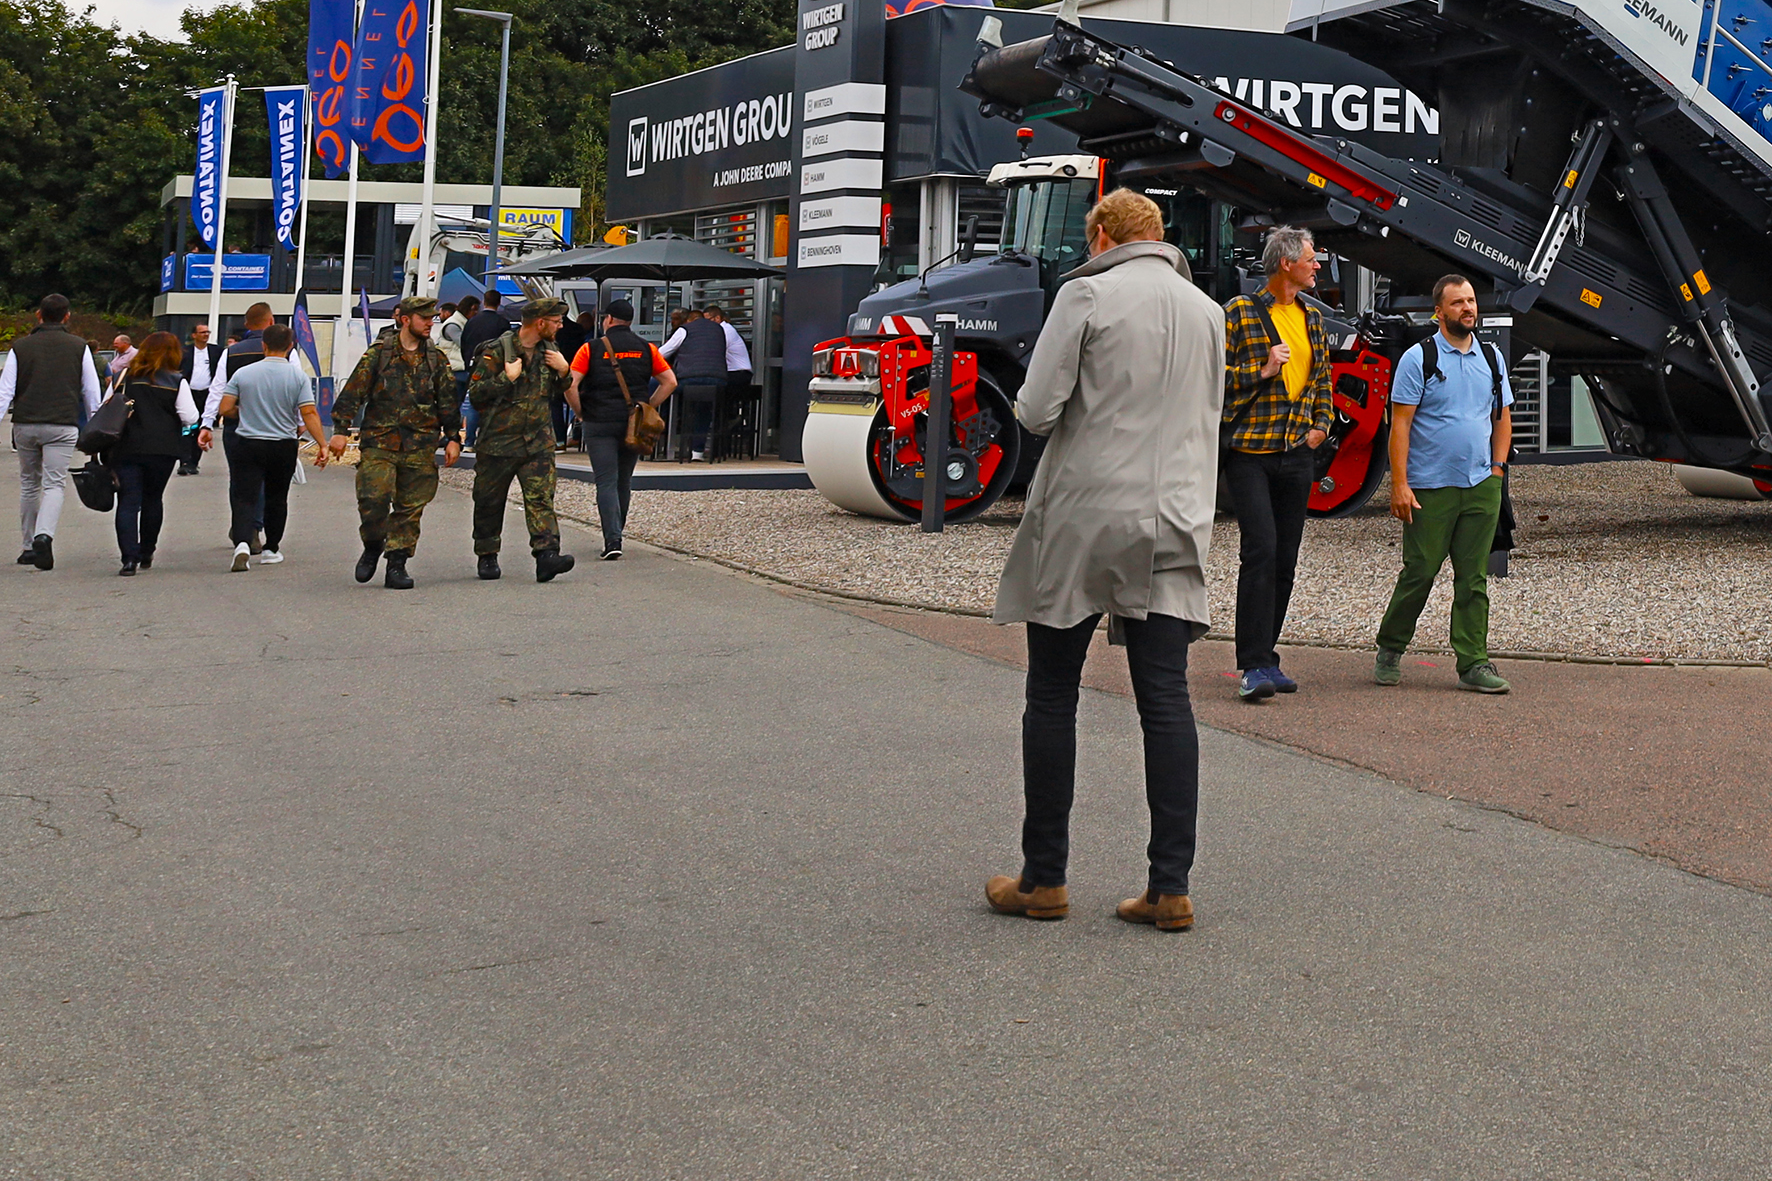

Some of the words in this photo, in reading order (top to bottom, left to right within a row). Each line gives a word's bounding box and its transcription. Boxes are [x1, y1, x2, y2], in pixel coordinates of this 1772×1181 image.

[803, 3, 844, 30] WIRTGEN
[805, 27, 839, 51] GROUP
[1194, 74, 1440, 135] WIRTGEN
[652, 106, 731, 163] WIRTGEN
[733, 91, 793, 146] GROU
[811, 134, 829, 146] VÖGELE
[713, 174, 720, 188] A
[720, 168, 740, 187] JOHN
[740, 164, 763, 184] DEERE
[764, 160, 792, 180] COMPA
[1144, 188, 1178, 196] COMPACT
[505, 212, 556, 224] RAUM
[808, 208, 833, 220] KLEEMANN
[807, 244, 842, 257] BENNINGHOVEN
[955, 319, 997, 331] HAMM
